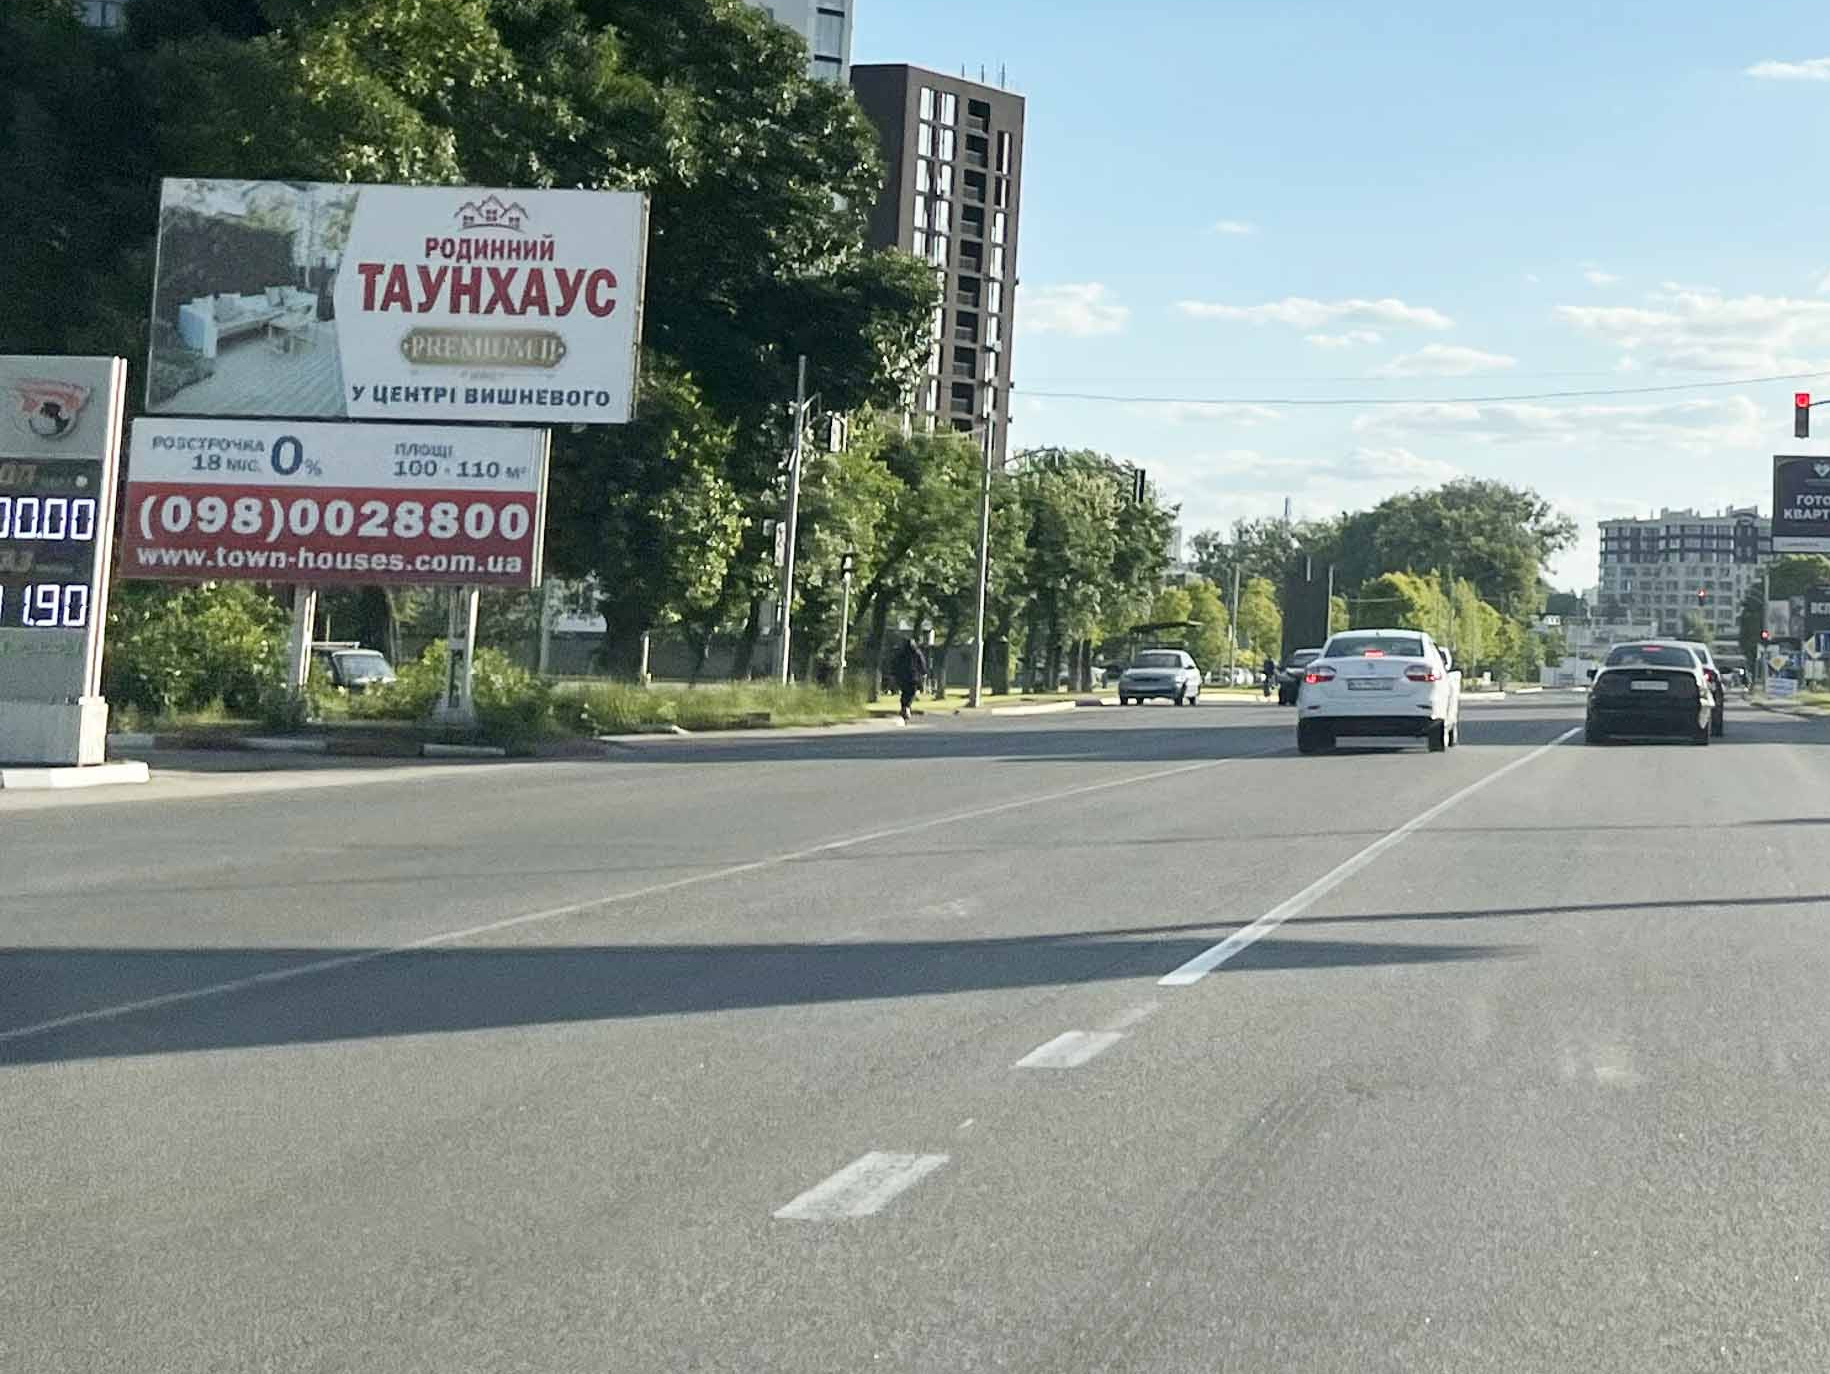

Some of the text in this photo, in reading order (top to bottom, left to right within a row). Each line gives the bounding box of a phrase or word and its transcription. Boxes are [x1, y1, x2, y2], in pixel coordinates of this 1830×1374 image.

[425, 234, 556, 263] РОДИННИЙ
[358, 262, 618, 318] ТАУНХАУС
[411, 334, 533, 361] PREMIUM
[351, 385, 611, 407] У ЦЕНТРІ ВИШНЕВОГО
[152, 434, 265, 452] РОЗСТРОЧКА
[394, 442, 454, 458] ПЛОЩІ
[191, 454, 222, 471] 18
[393, 460, 438, 477] 100
[456, 461, 500, 478] 110
[139, 495, 531, 543] (098)0028800
[136, 545, 522, 574] www.town-houses.com.ua
[0, 584, 89, 627] 1.90
